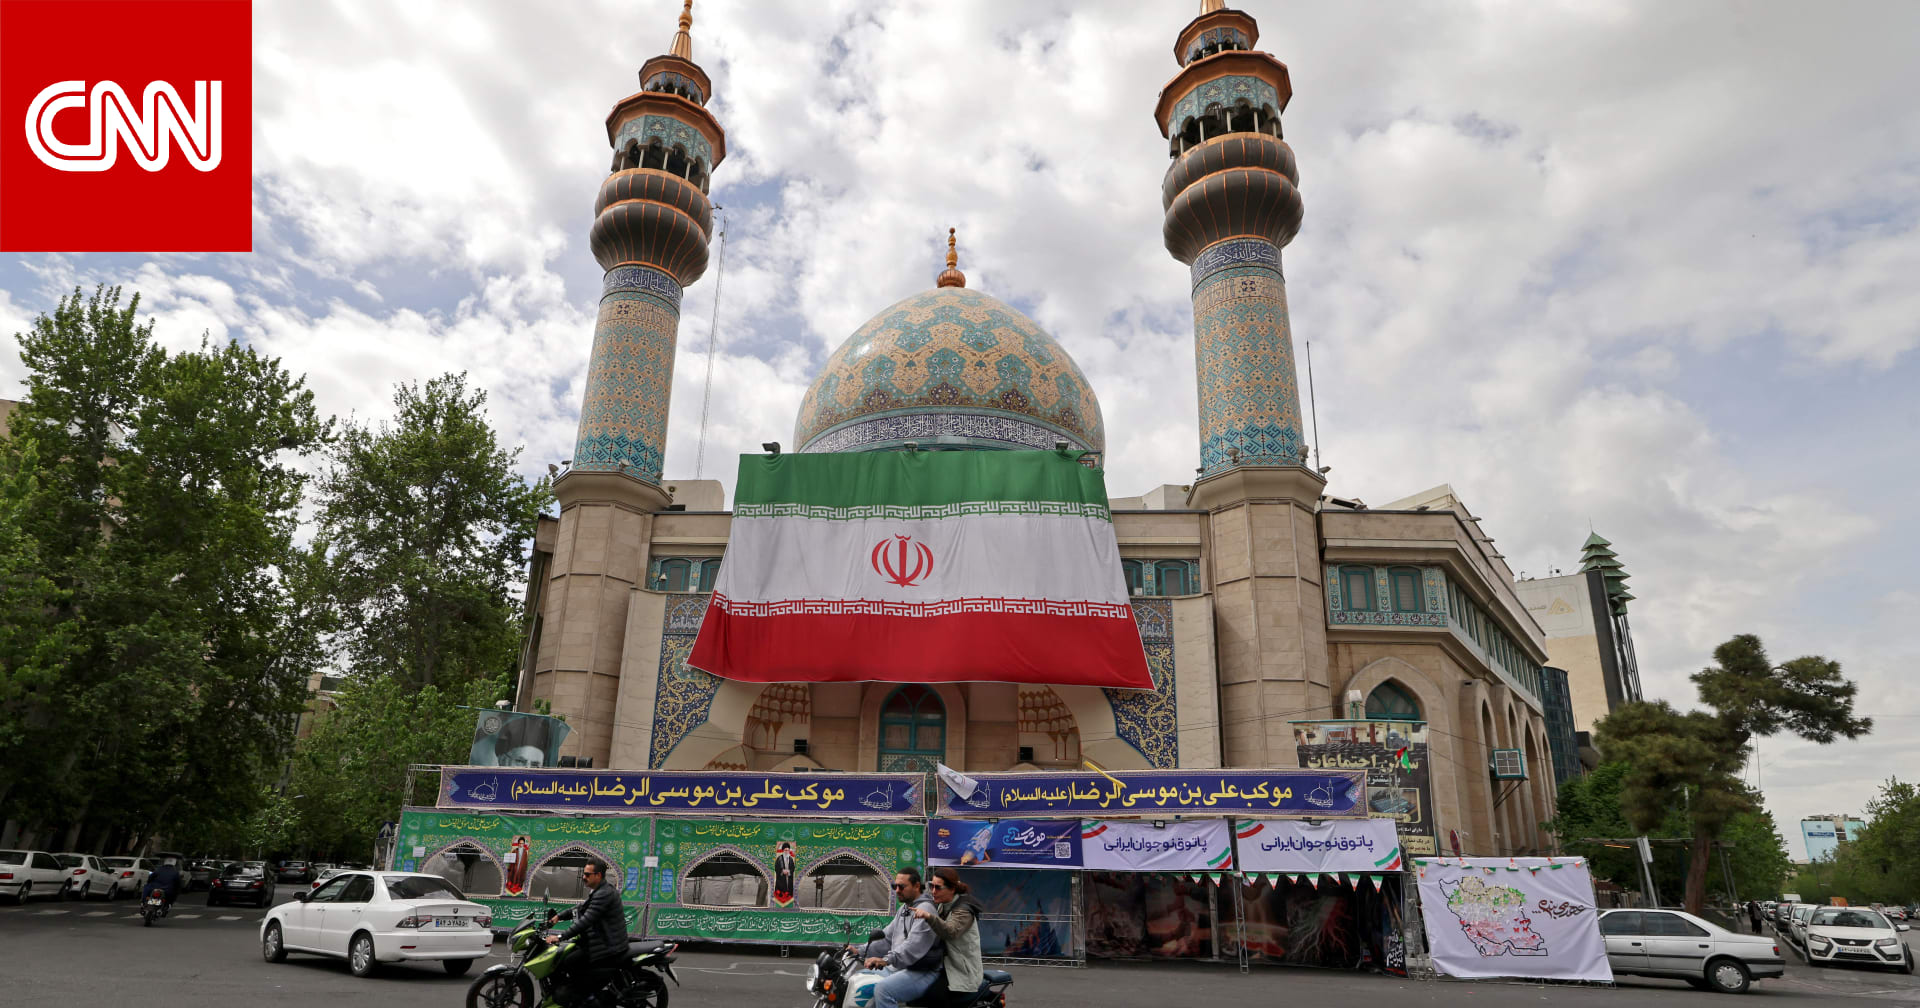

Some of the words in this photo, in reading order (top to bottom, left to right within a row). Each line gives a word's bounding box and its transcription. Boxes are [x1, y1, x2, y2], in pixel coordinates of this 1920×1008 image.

[650, 785, 715, 807] موسی
[715, 781, 742, 806] بن
[742, 778, 784, 806] علی
[785, 782, 845, 809] موکب
[1122, 784, 1178, 807] موسی
[1178, 782, 1202, 806] بن
[1202, 778, 1239, 806] علی
[1240, 781, 1293, 808] موکب
[1103, 836, 1133, 852] ایرانی
[1132, 837, 1175, 852] نوجوان
[1174, 836, 1207, 853] پاتوق
[1261, 835, 1293, 852] ایرانی
[1292, 836, 1338, 852] نوجوان
[1337, 835, 1373, 853] پاتوق
